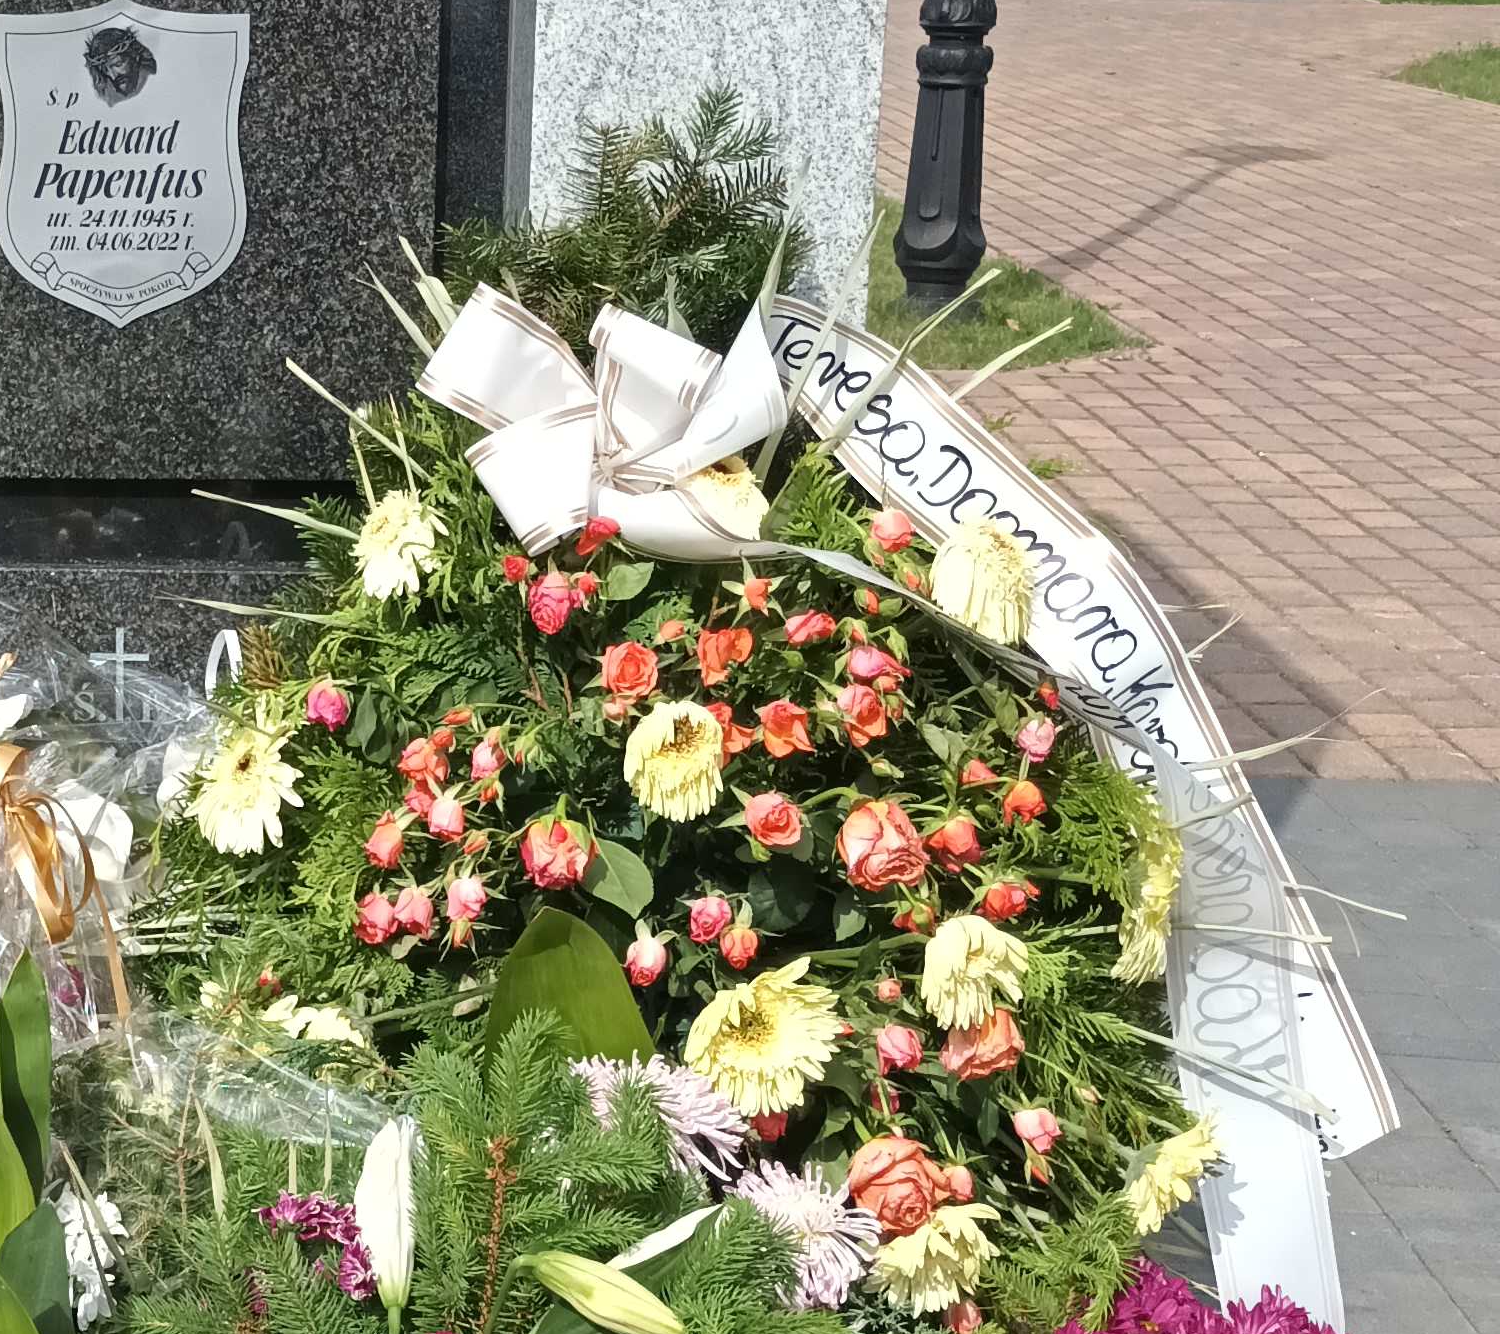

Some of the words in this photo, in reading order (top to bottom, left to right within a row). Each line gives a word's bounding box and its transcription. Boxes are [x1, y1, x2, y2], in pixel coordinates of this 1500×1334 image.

[57, 119, 181, 155] Edward
[33, 162, 207, 206] Papenfus
[46, 212, 73, 228] ur.
[79, 209, 178, 229] 24.11.1945
[49, 234, 81, 251] zm.
[86, 232, 180, 252] 04.06.2022
[126, 292, 135, 300] W
